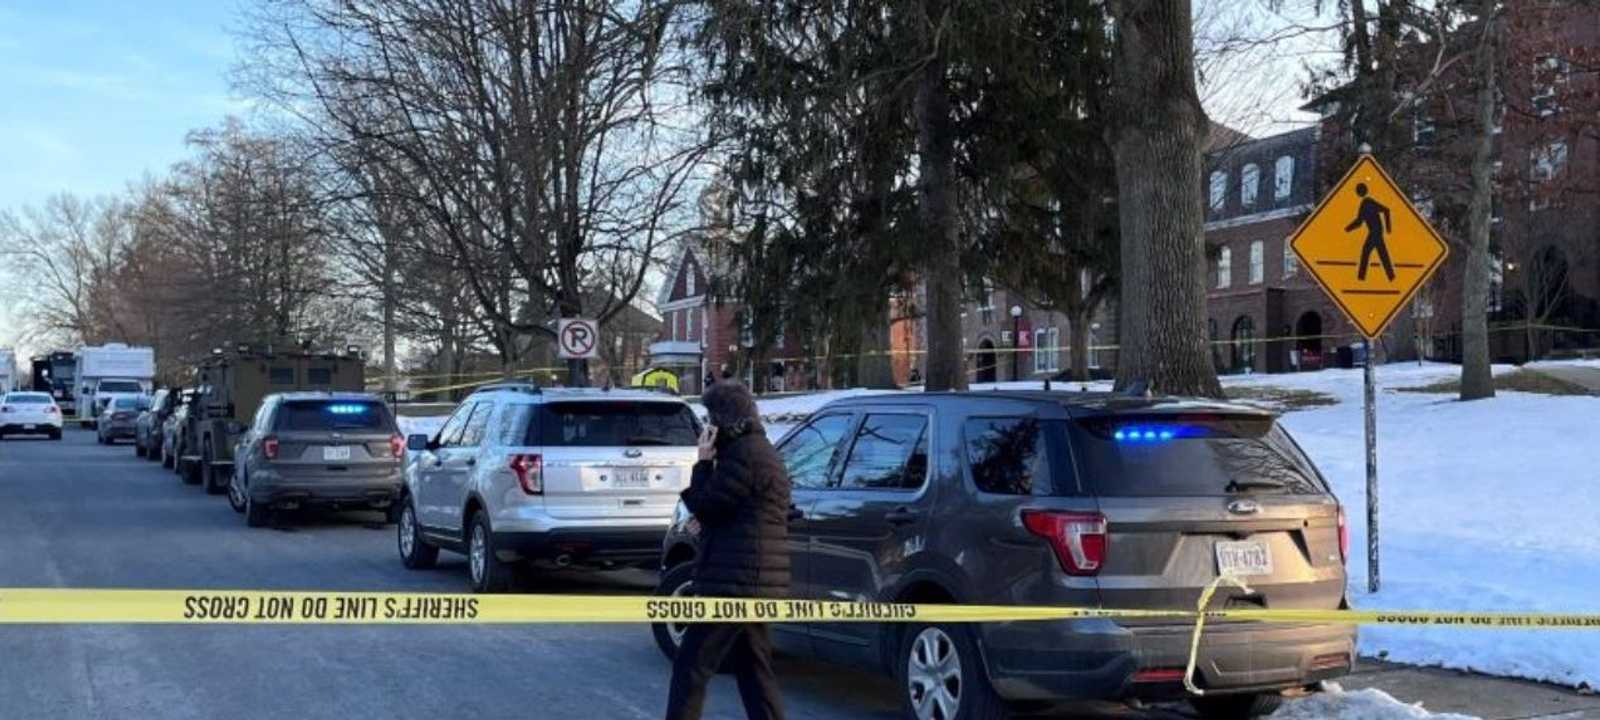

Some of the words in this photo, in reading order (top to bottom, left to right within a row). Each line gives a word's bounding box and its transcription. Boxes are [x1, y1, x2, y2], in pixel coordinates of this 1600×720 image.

[184, 596, 249, 619] CROSS
[254, 597, 294, 619] NOT
[302, 597, 327, 619] DO
[334, 597, 377, 619] LINE
[384, 597, 479, 619] SHERIFF'S
[646, 601, 706, 618] CROSS
[712, 601, 747, 618] NOT
[754, 601, 778, 618] DO
